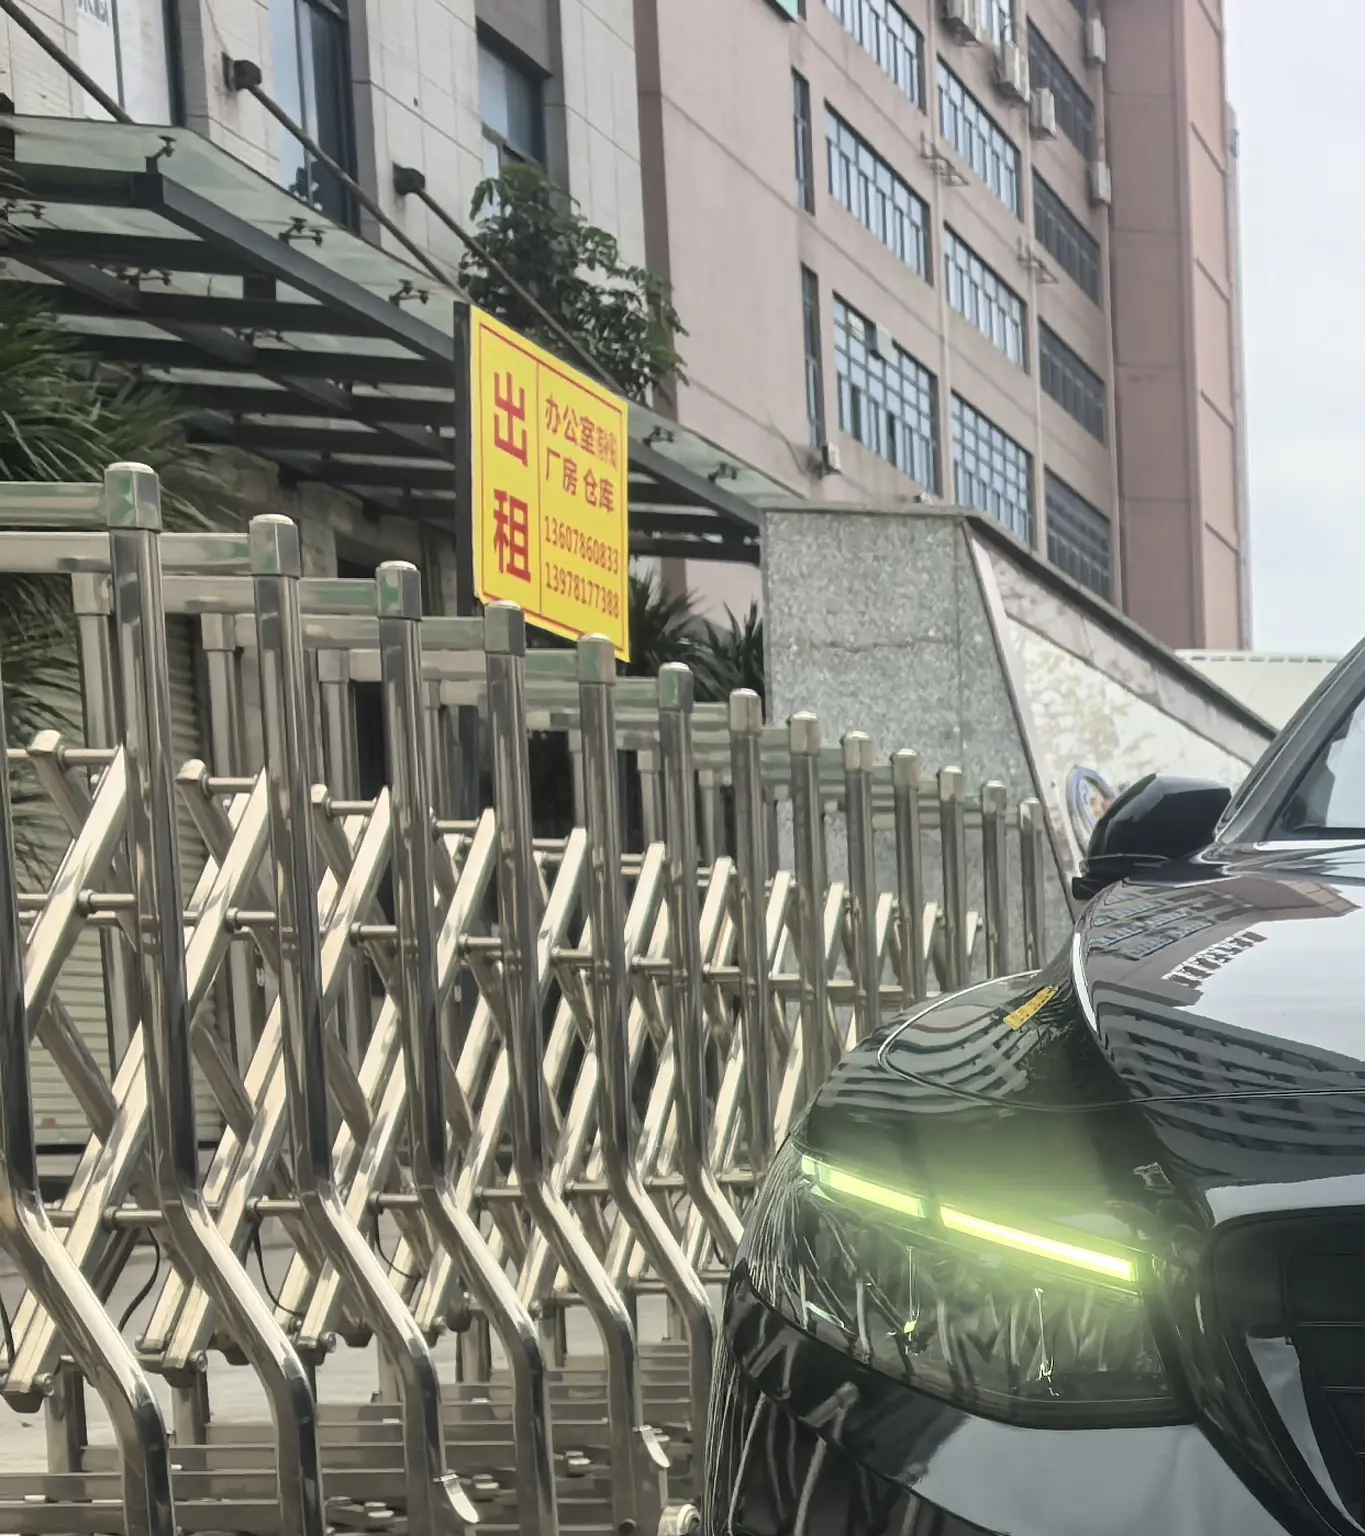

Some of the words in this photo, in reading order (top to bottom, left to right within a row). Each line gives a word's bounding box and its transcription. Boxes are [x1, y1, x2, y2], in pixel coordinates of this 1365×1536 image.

[493, 371, 531, 584] 出租
[545, 446, 578, 496] 厂房
[583, 468, 615, 513] 仓库
[544, 515, 620, 576] 13607860833
[545, 561, 620, 619] 13978177388
